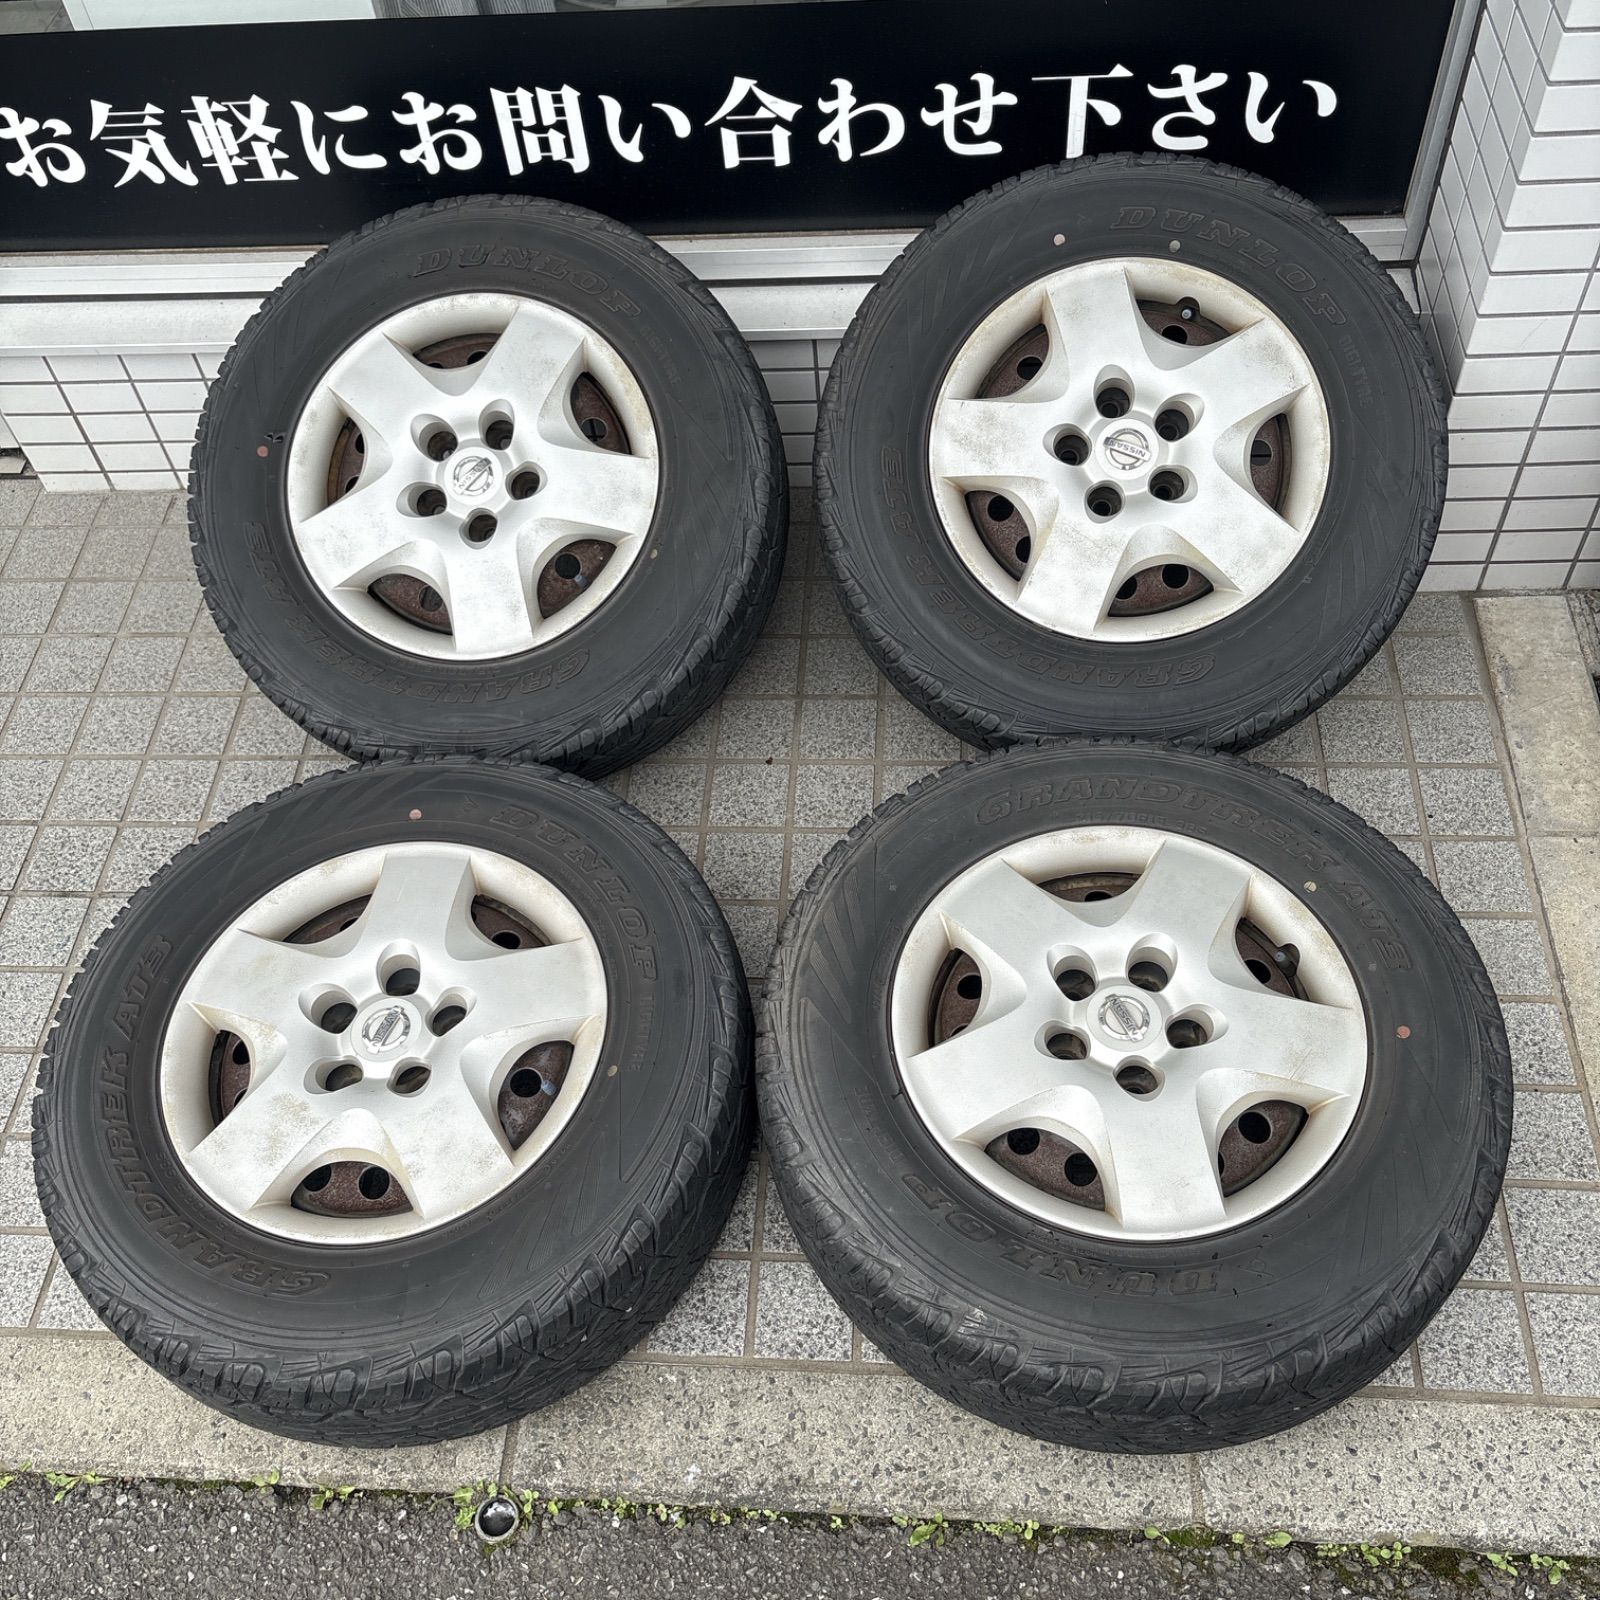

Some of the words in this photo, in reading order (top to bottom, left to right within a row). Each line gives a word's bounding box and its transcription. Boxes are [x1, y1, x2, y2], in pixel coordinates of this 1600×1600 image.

[0, 64, 1338, 188] お気軽にお問い合わせ下さい
[408, 243, 642, 317] DUNLOP
[1110, 205, 1348, 327] DUNLOP
[1106, 438, 1147, 459] NISSAN
[284, 614, 591, 704] GRANDTREK
[905, 553, 1217, 688] GRANDTREK
[975, 777, 1341, 872] GRANDTREK
[489, 804, 659, 982] DUNLOP
[112, 935, 175, 1041] AT3
[101, 1046, 333, 1297] GRANDTREK
[902, 1173, 1217, 1298] DUNLOP
